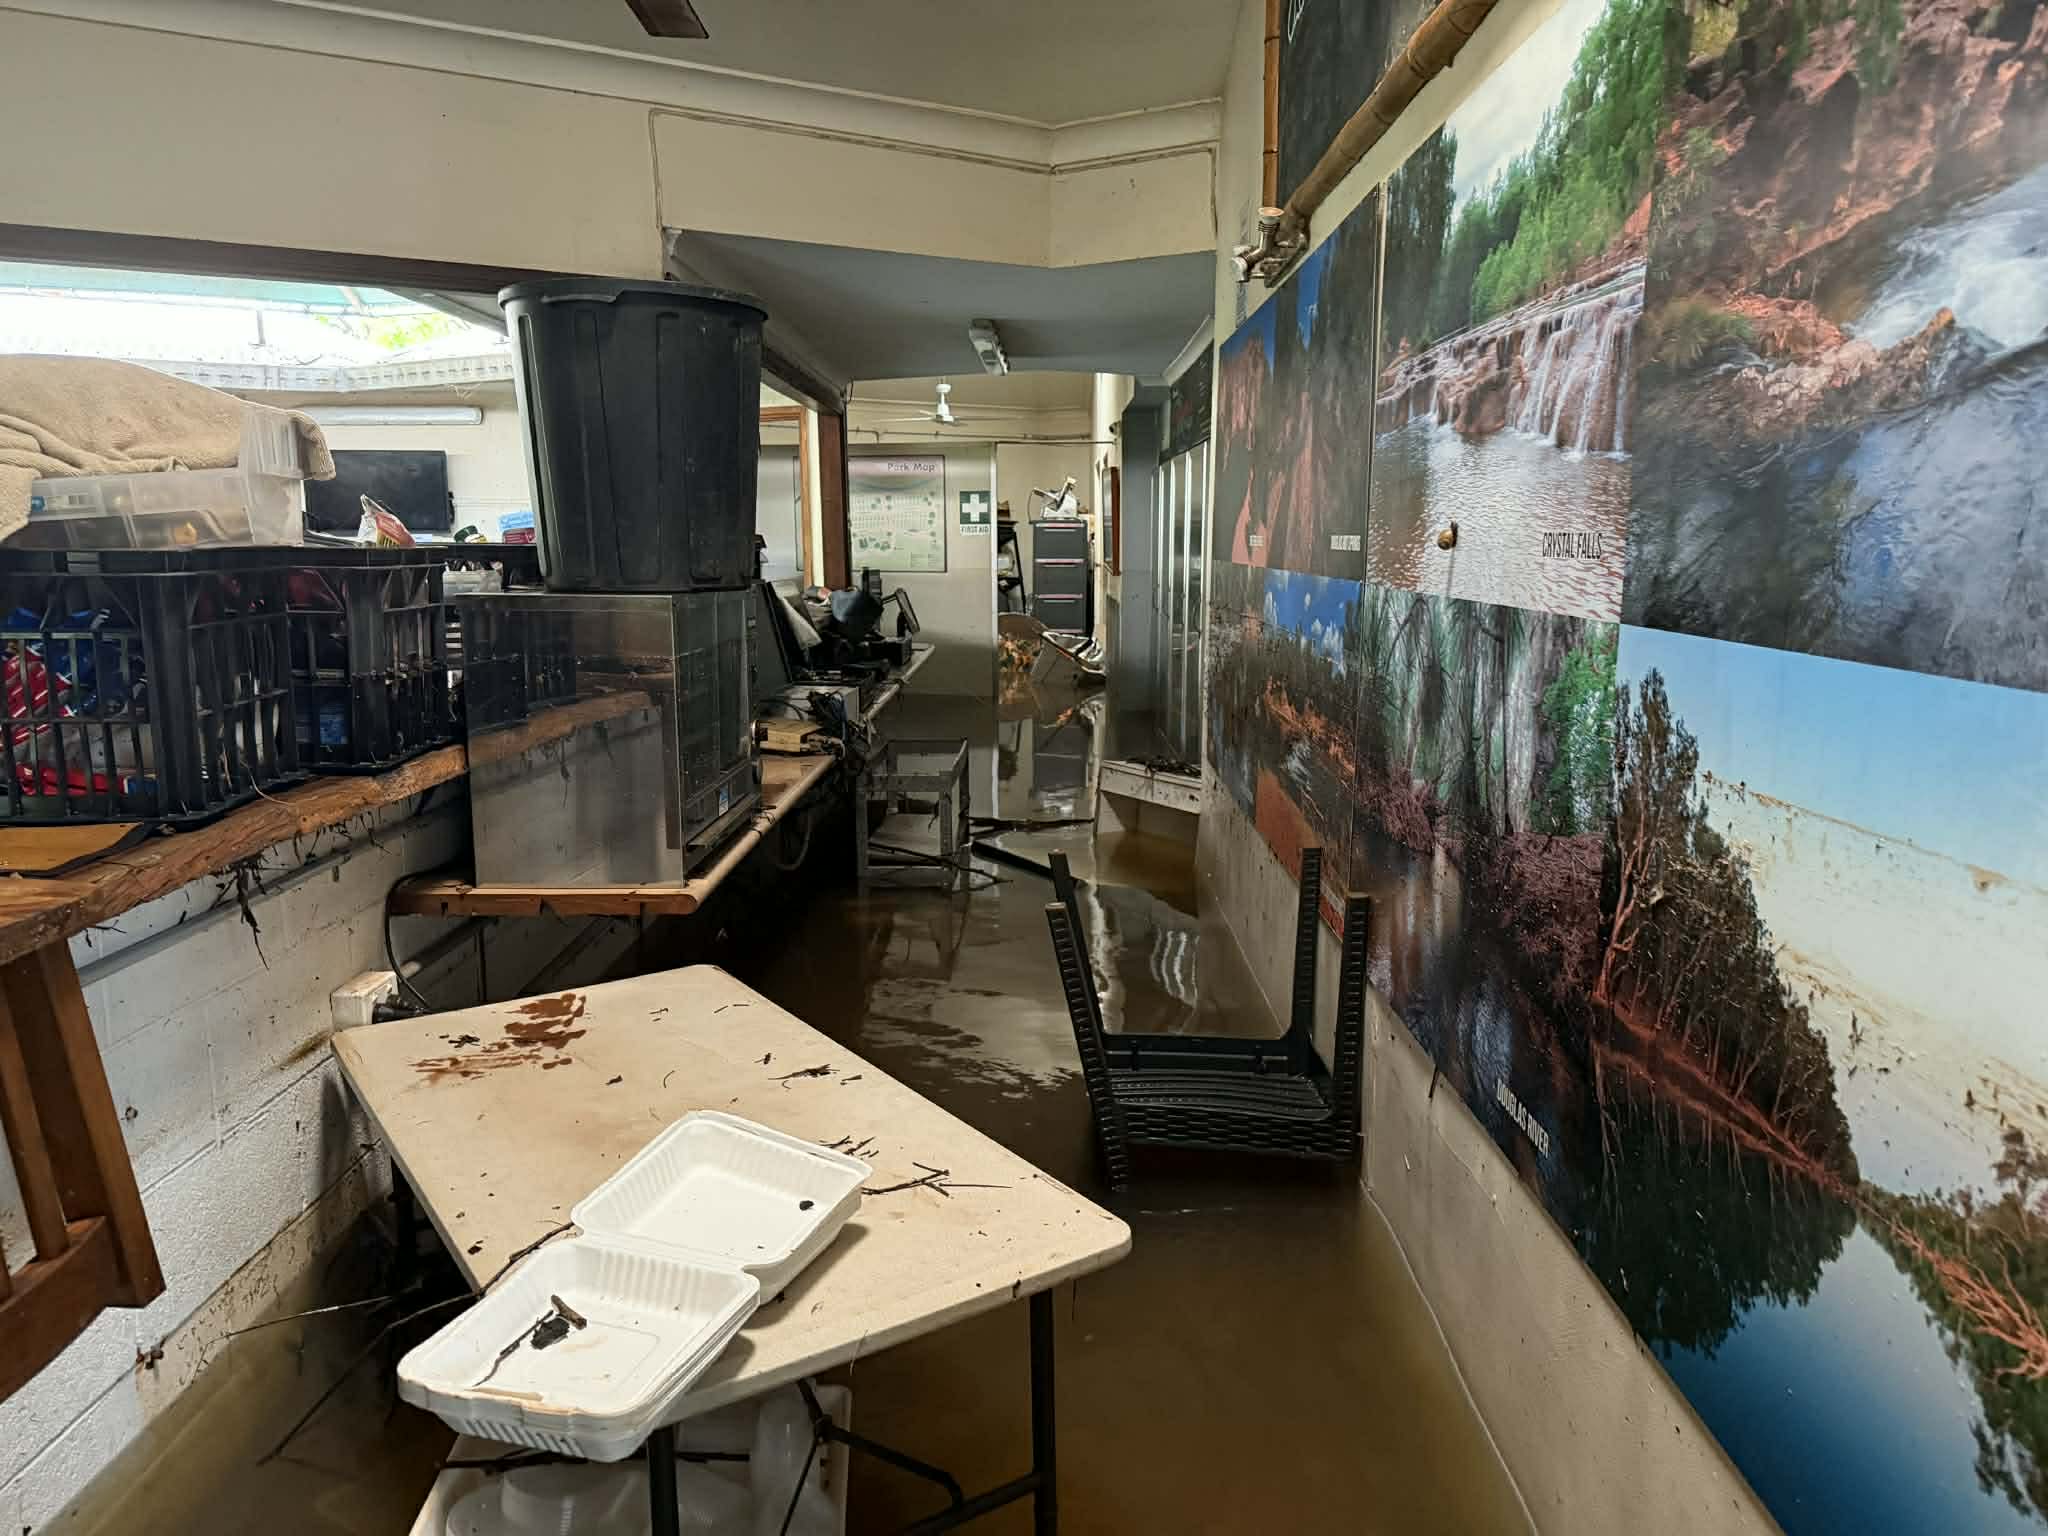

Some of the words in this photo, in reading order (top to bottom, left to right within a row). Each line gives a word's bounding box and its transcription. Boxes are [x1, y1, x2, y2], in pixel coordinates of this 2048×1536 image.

[887, 462, 908, 471] Park
[913, 462, 936, 472] Map
[960, 525, 978, 534] FIRST
[1542, 532, 1575, 558] CRYSTAL
[1576, 533, 1602, 559] FALLS
[1496, 1078, 1527, 1131] DOUGLAS
[1527, 1113, 1549, 1159] RIVER
